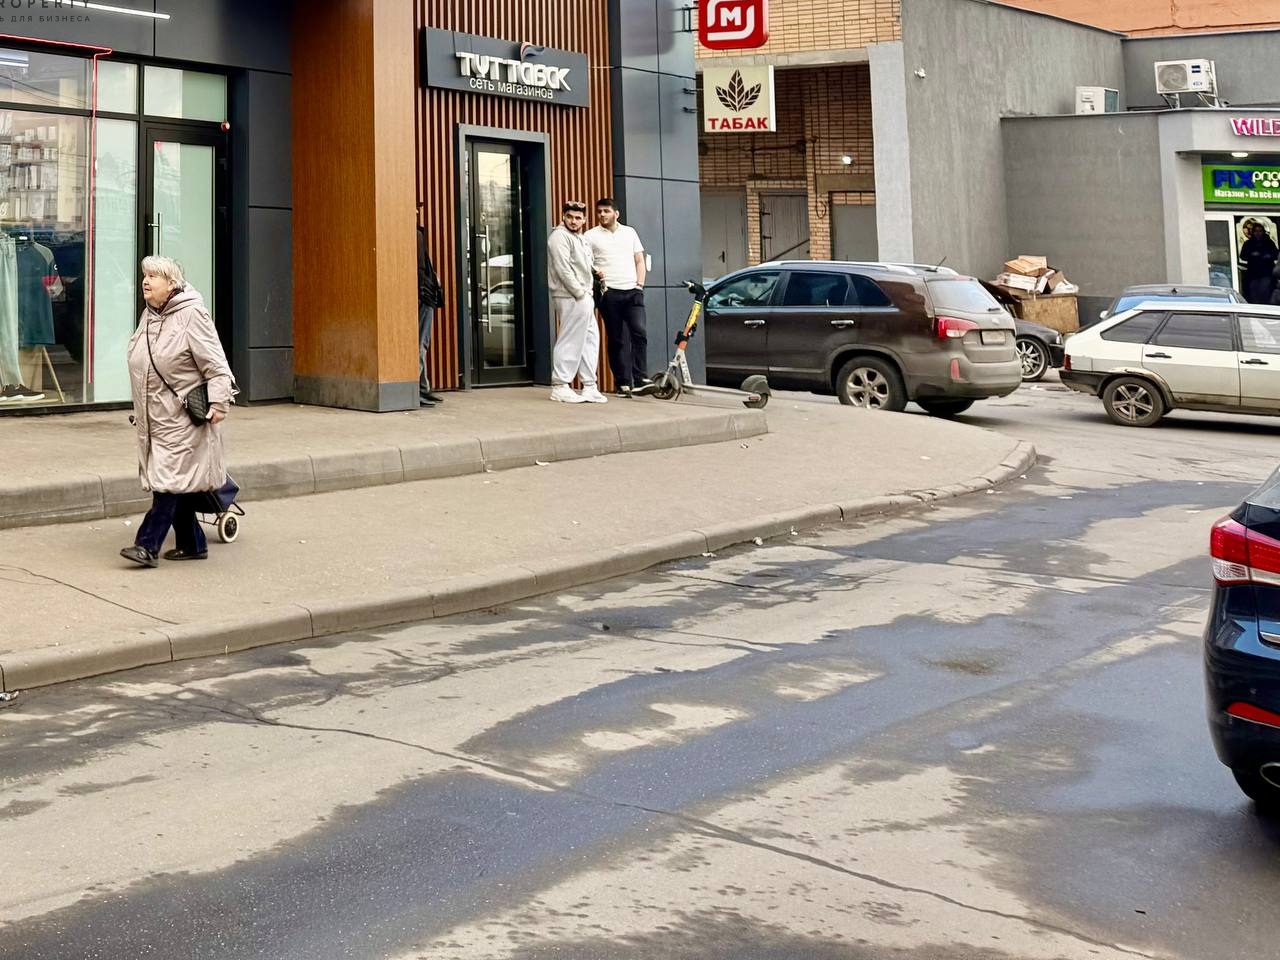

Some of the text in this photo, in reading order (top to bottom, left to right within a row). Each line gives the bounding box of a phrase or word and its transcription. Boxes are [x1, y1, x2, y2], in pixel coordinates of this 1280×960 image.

[469, 77, 555, 99] сеть магазинов
[708, 116, 768, 130] ТАБАК
[1252, 171, 1280, 183] pric
